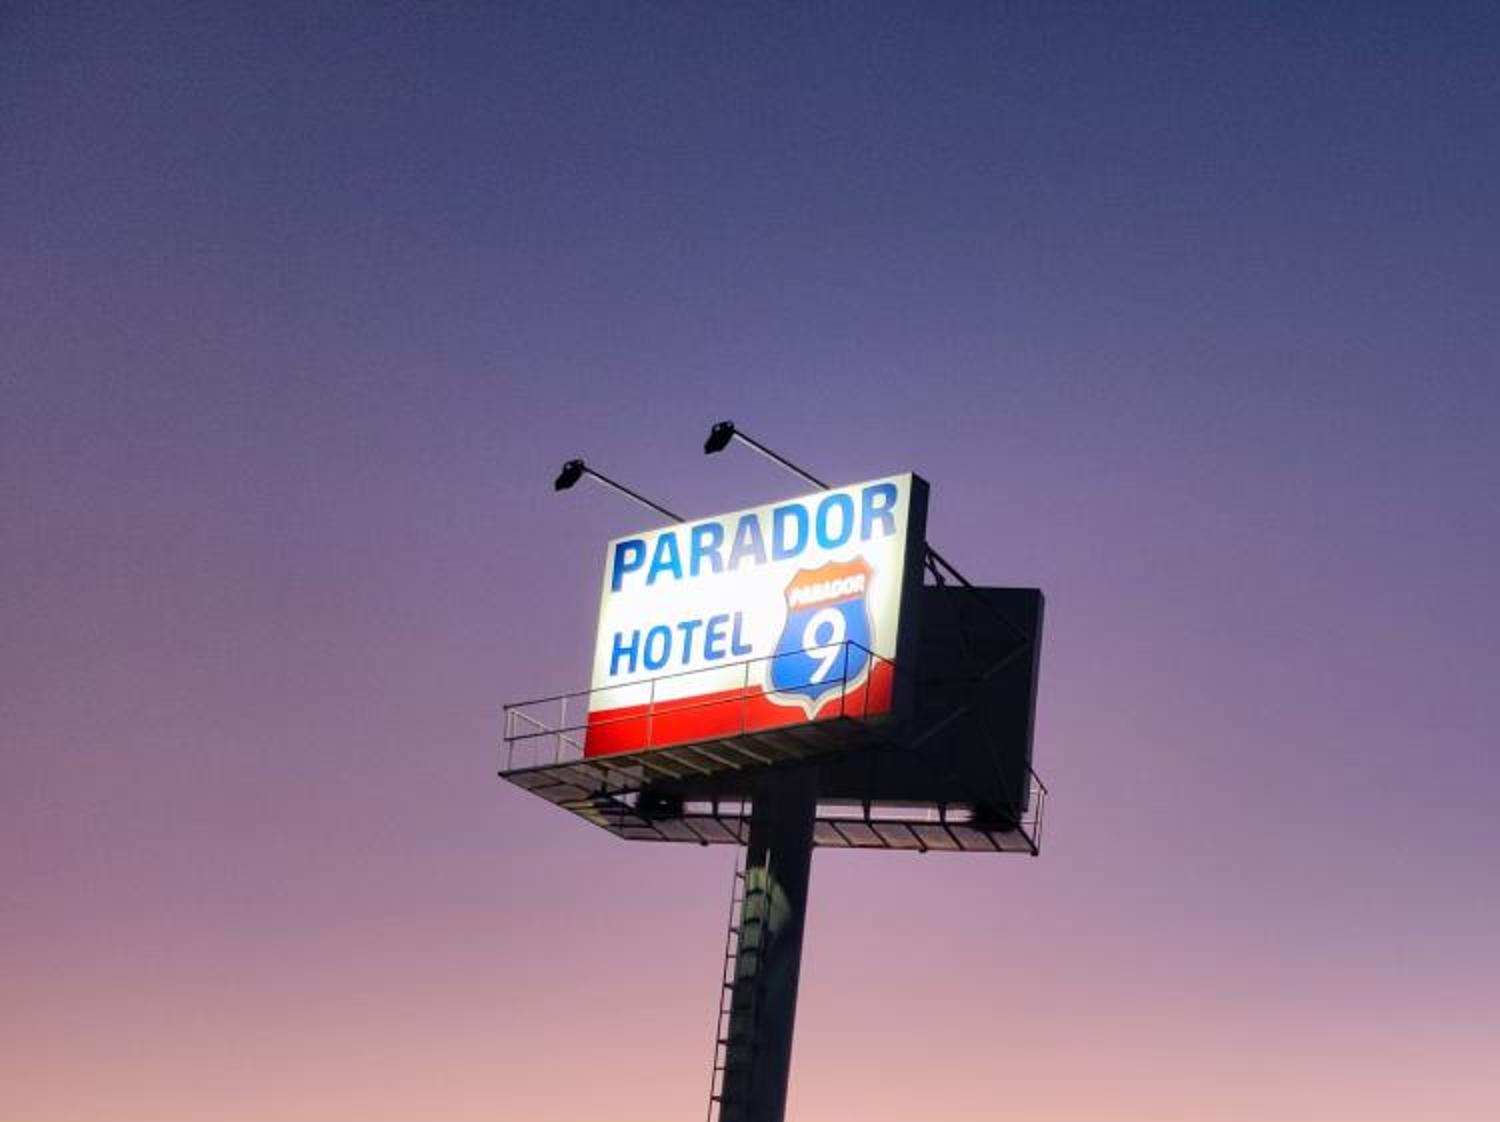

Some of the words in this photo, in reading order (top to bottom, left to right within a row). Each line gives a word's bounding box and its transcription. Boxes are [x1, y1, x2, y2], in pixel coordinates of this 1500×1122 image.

[611, 482, 897, 593] PARADOR
[609, 611, 752, 676] HOTEL
[803, 607, 846, 684] 9
